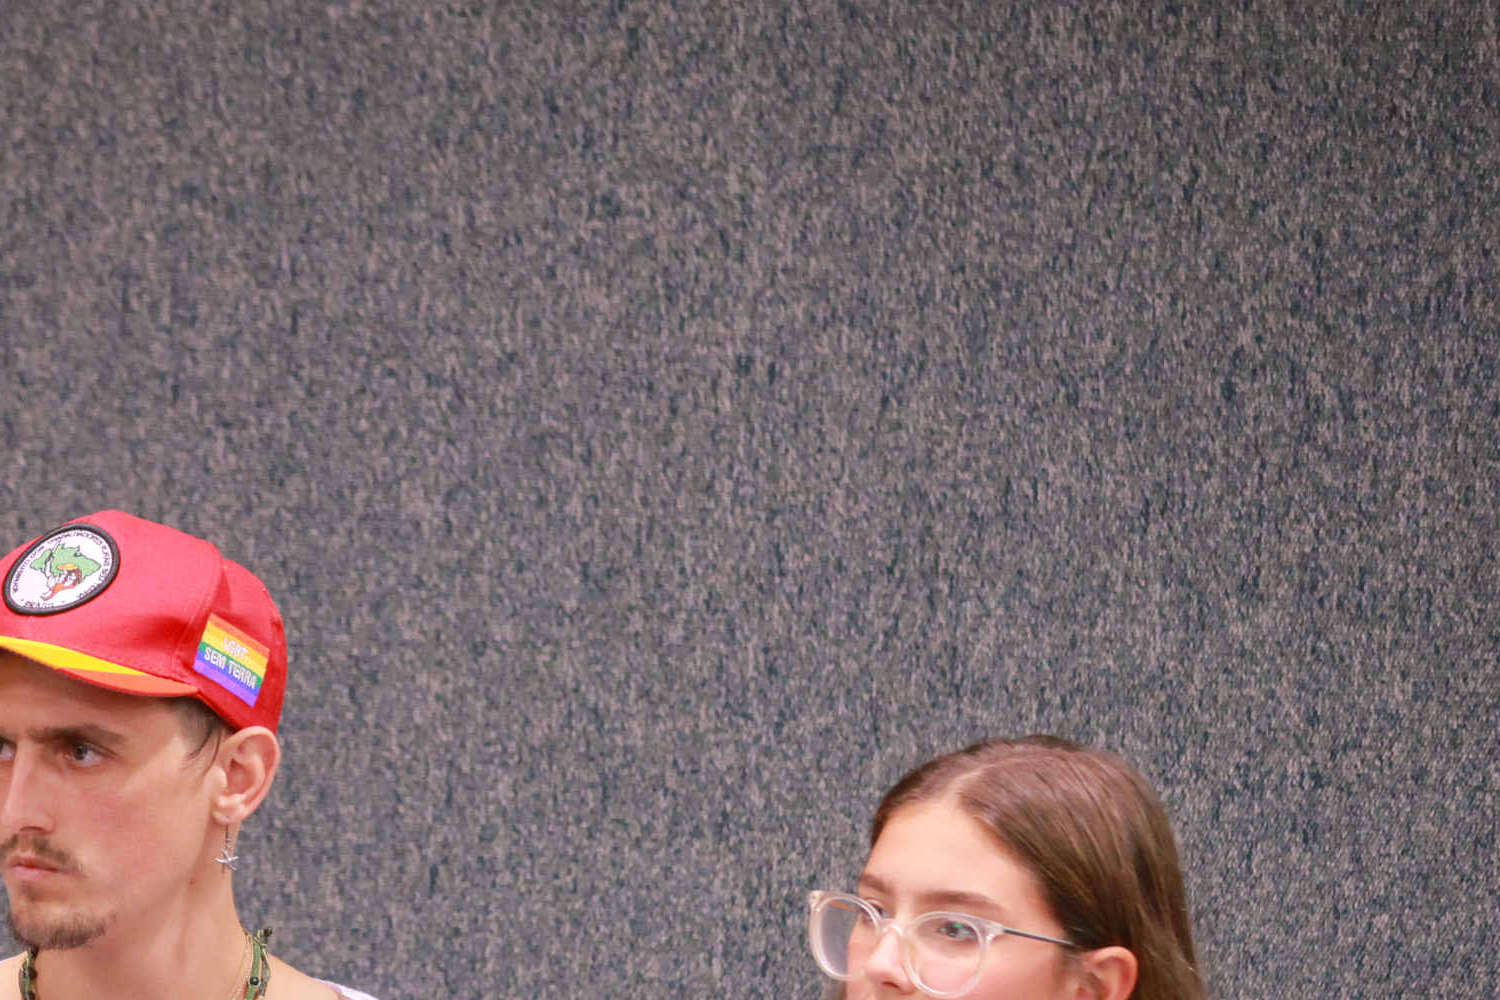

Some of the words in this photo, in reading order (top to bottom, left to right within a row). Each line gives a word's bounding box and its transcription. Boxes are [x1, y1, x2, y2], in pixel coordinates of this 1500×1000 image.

[223, 637, 249, 661] LGBT
[204, 646, 227, 670] SEM
[228, 660, 257, 690] TERRA
